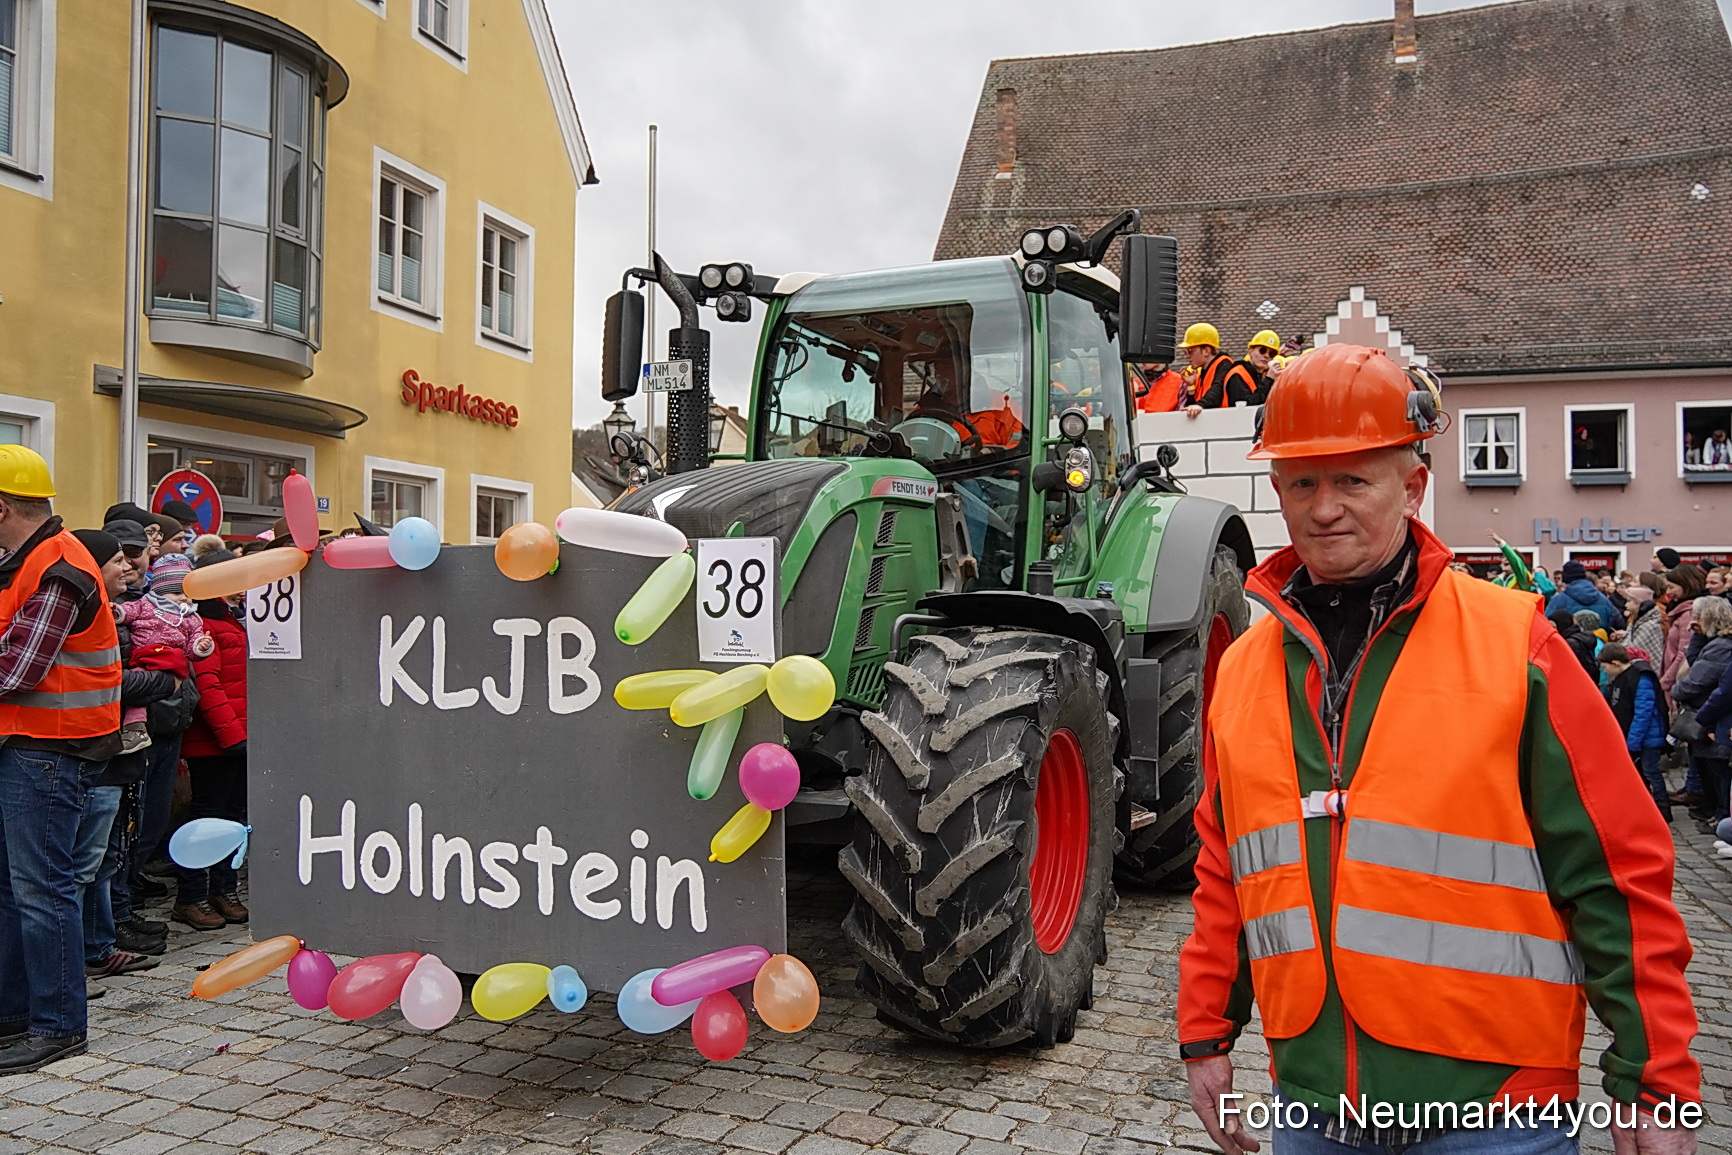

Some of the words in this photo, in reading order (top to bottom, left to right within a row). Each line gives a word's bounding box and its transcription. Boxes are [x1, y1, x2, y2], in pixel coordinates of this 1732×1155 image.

[654, 363, 669, 376] NM
[402, 369, 519, 428] Sparkasse
[319, 498, 328, 508] 19
[891, 480, 915, 495] FENDT
[915, 484, 927, 496] 514
[1533, 516, 1664, 544] Hutter
[251, 575, 295, 622] 38
[703, 558, 766, 618] 38
[378, 614, 602, 716] KLJB
[298, 794, 708, 933] Holnstein
